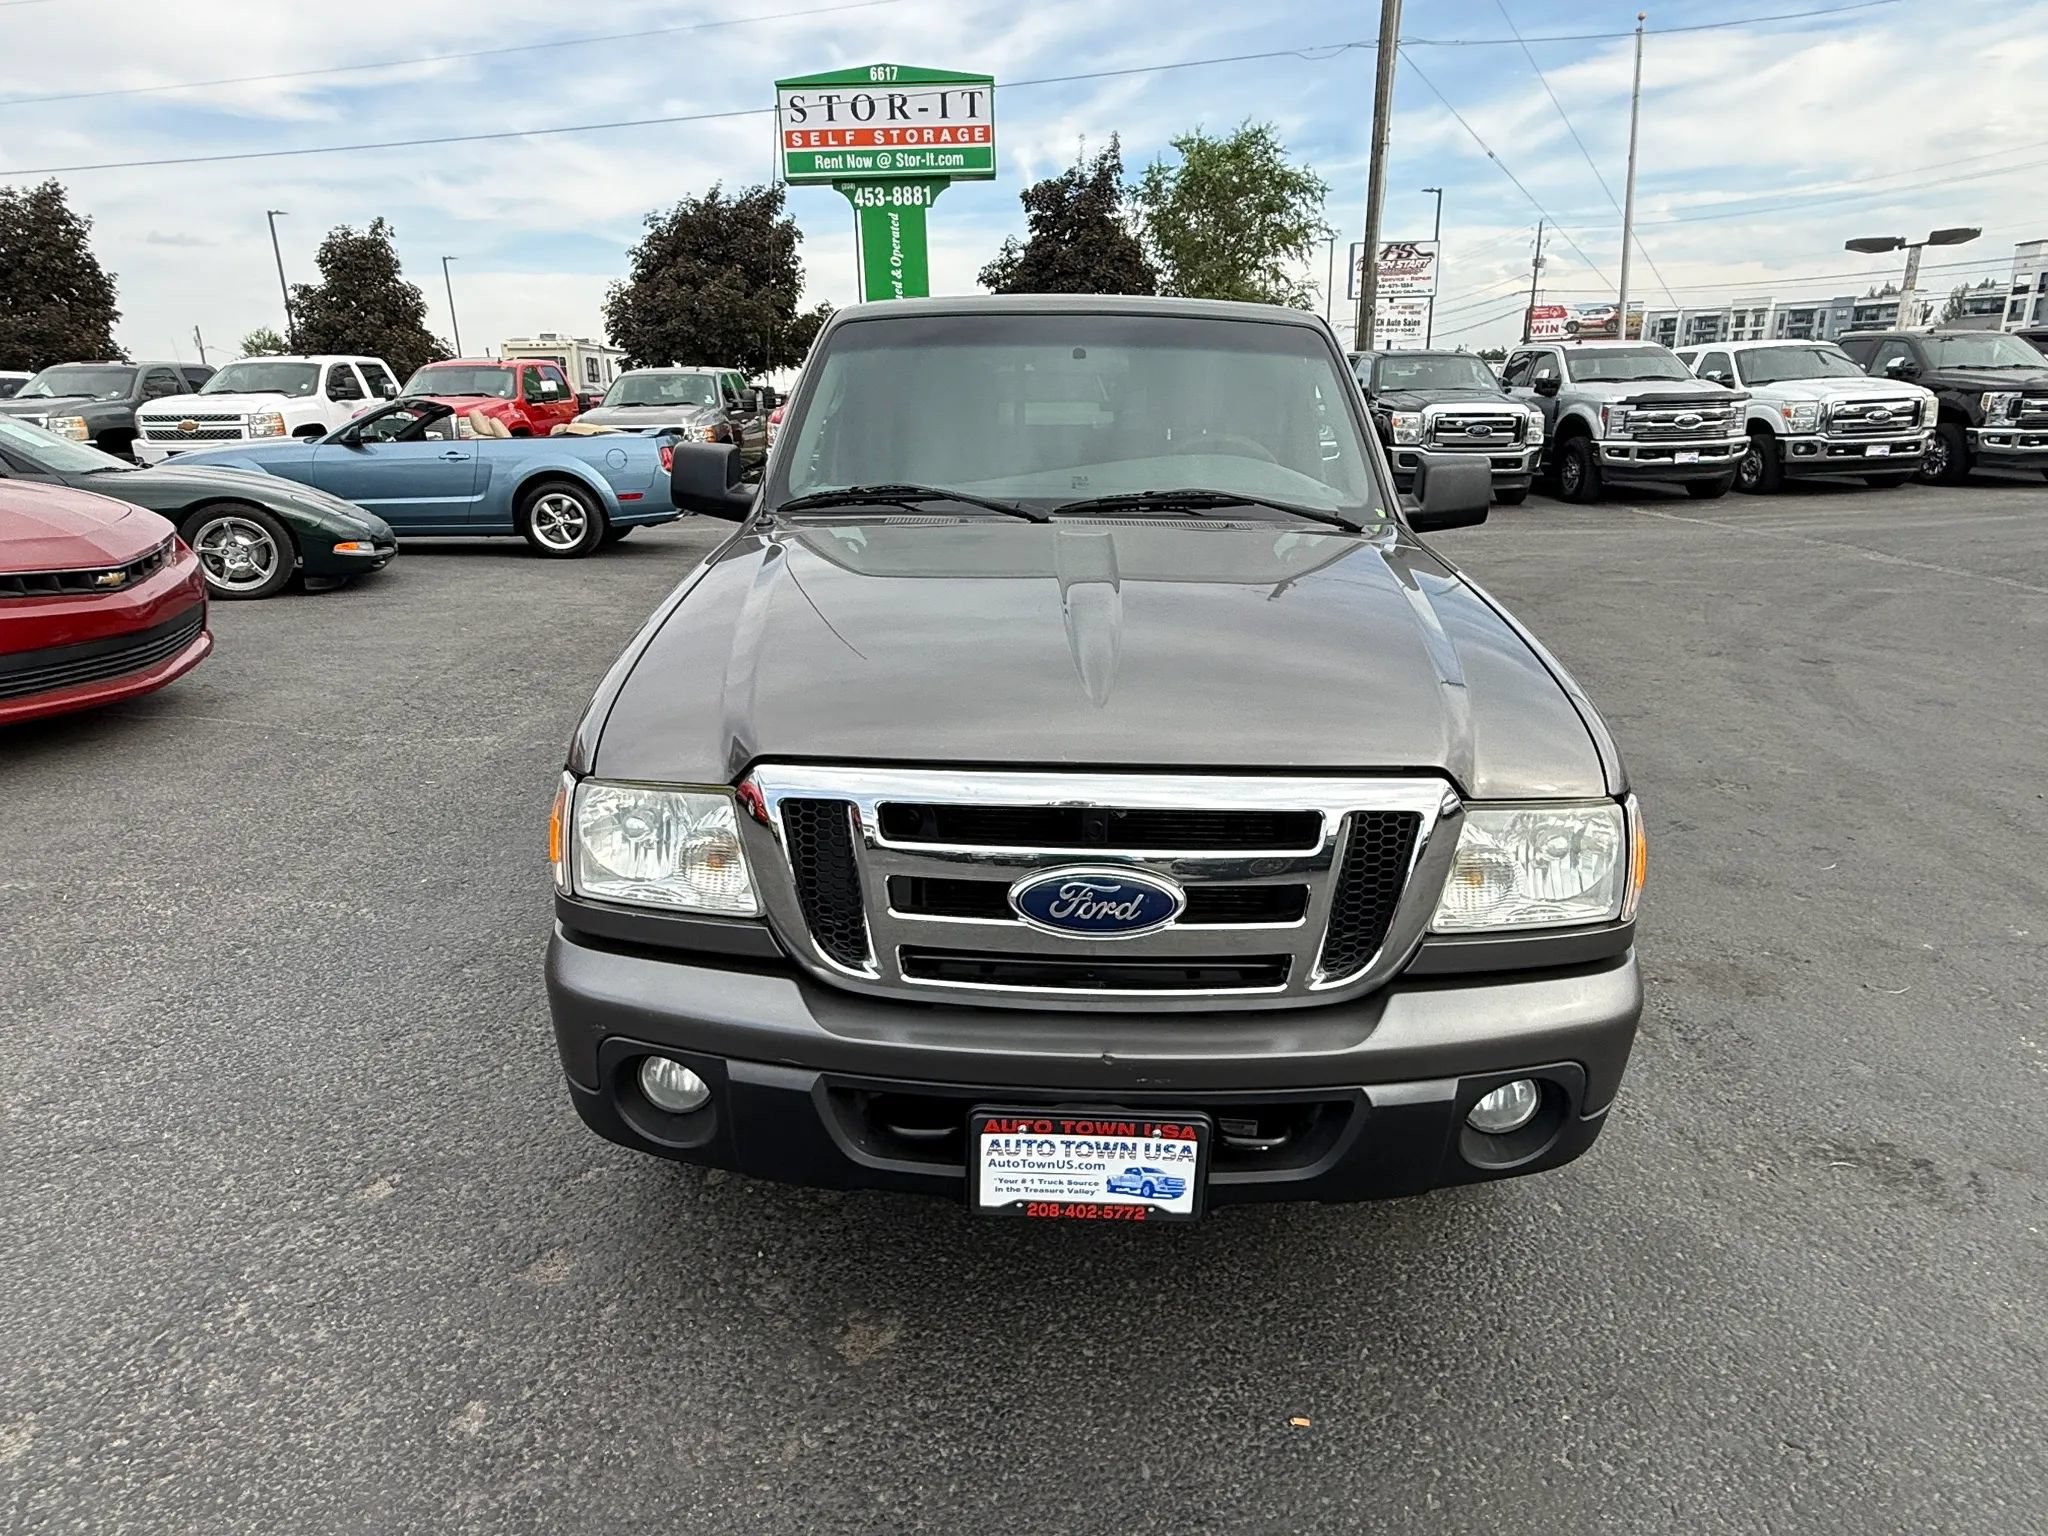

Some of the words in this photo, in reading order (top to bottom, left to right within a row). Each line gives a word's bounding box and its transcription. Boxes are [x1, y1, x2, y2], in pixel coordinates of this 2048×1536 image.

[870, 66, 898, 81] 6617
[789, 91, 983, 123] STOR-IT
[791, 131, 855, 146] SELF
[874, 127, 985, 145] STORAGE
[815, 155, 843, 169] Rent
[846, 154, 872, 169] Now
[876, 152, 892, 168] @
[896, 153, 964, 168] Stor-It.com
[854, 186, 932, 207] 453-8881
[887, 212, 904, 267] Operated
[890, 268, 903, 280] &
[1531, 324, 1559, 334] WIN
[1050, 881, 1144, 921] Ford
[984, 1119, 1054, 1133] AUTO
[1060, 1120, 1135, 1136] TOWN
[1144, 1123, 1197, 1139] USA
[986, 1139, 1056, 1157] AUTO
[1060, 1140, 1137, 1159] TOWN
[1144, 1142, 1195, 1162] USA
[988, 1158, 1106, 1170] AutoTownUS.com
[1024, 1186, 1065, 1194] Treasure
[1067, 1179, 1100, 1187] Source
[1026, 1202, 1146, 1220] 208-402-5772
